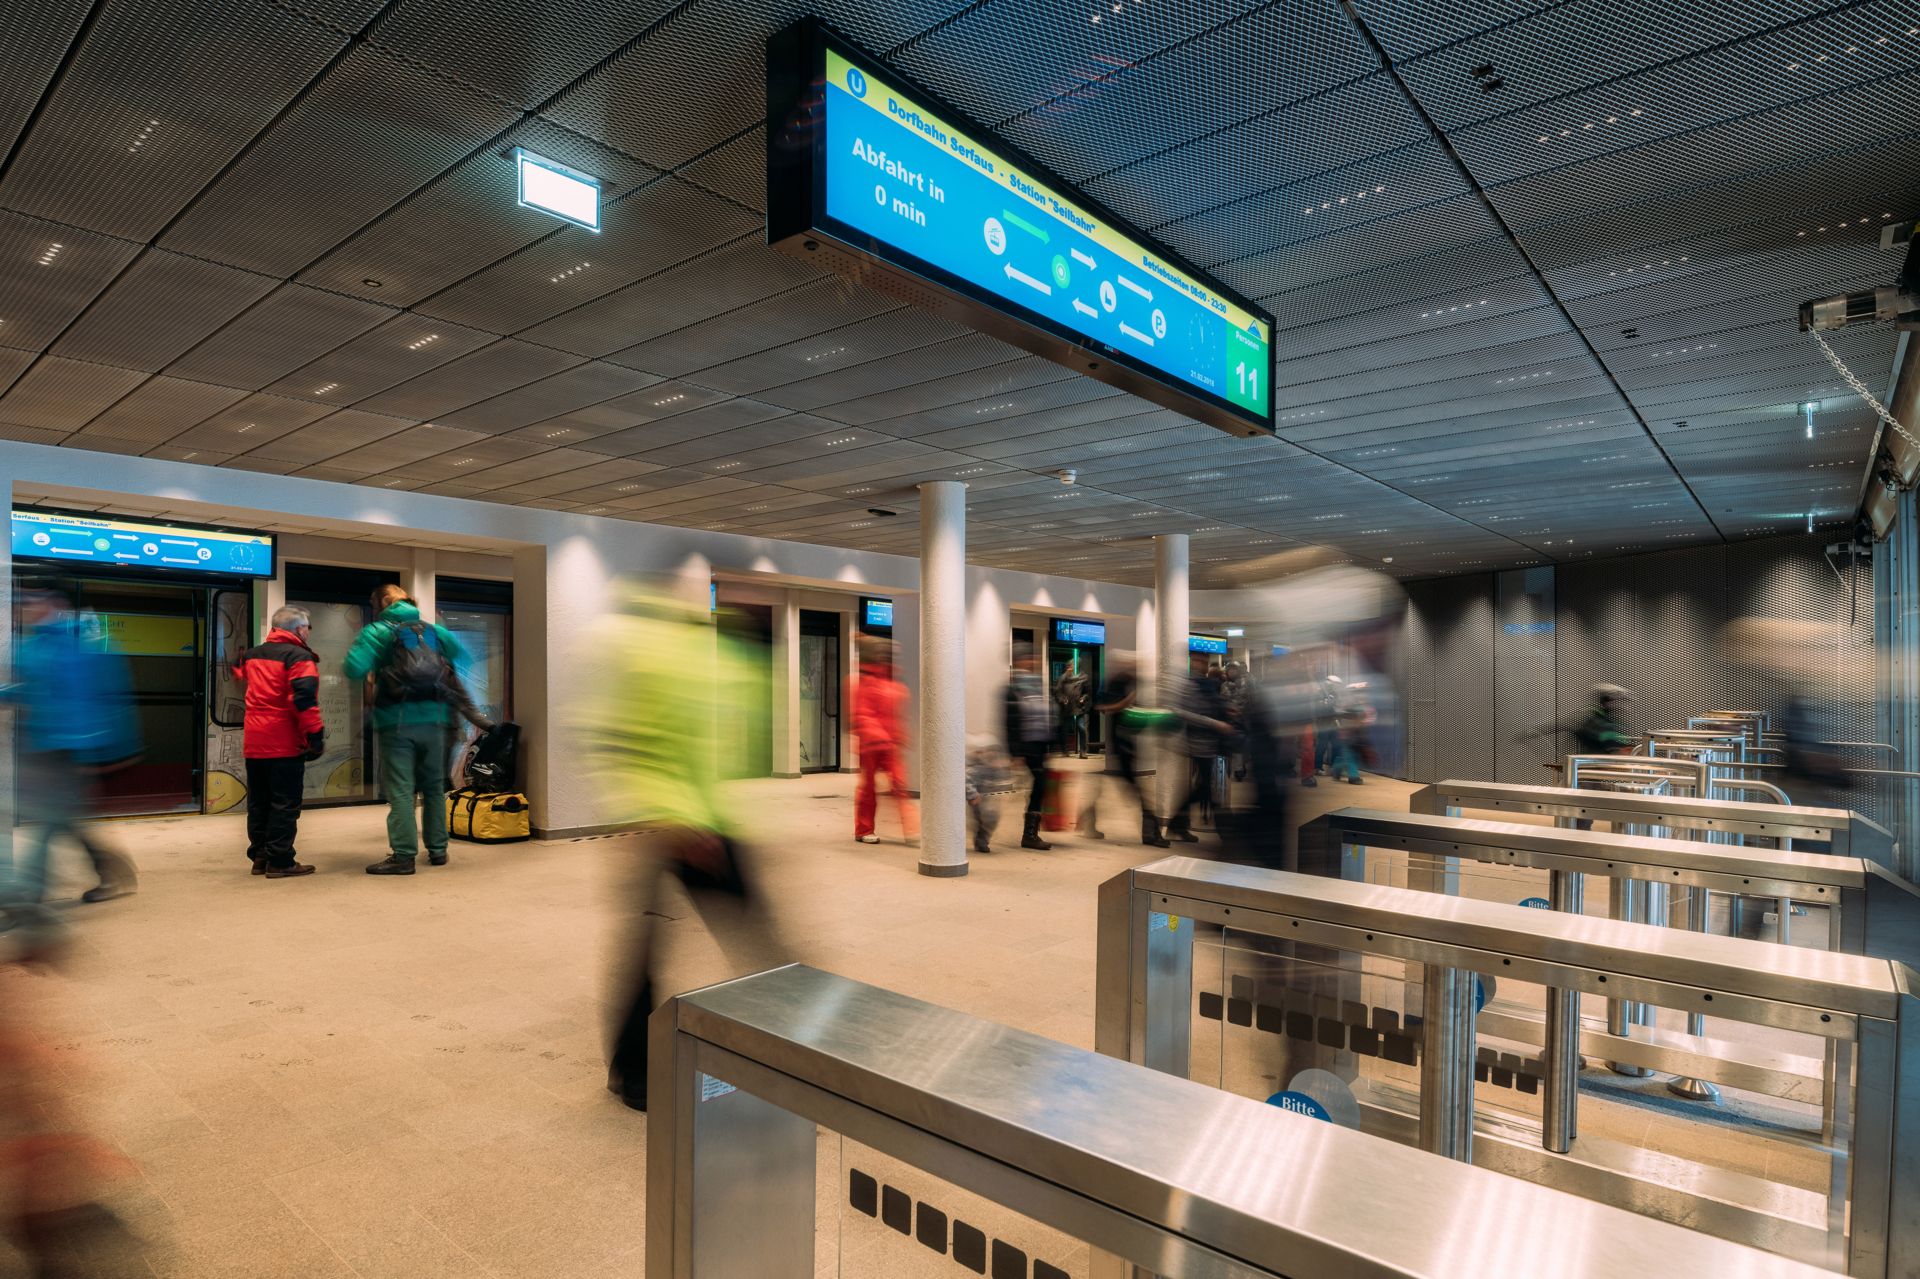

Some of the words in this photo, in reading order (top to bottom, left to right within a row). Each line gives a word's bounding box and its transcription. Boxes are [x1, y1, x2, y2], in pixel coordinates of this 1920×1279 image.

[852, 137, 924, 192] Abfahrt
[929, 178, 945, 204] in
[888, 97, 947, 145] Dorfbahn
[950, 136, 994, 174] Serfaus
[1010, 173, 1046, 205] Station
[1048, 196, 1096, 233] "Seilbahn"
[875, 184, 887, 206] 0
[893, 197, 926, 227] min
[1235, 330, 1260, 351] Personen
[1235, 361, 1258, 401] 11
[12, 513, 40, 521] Serfaus
[76, 519, 112, 528] "Seilbahn"
[1528, 900, 1549, 910] Bitte
[1282, 1096, 1316, 1117] Bitte
